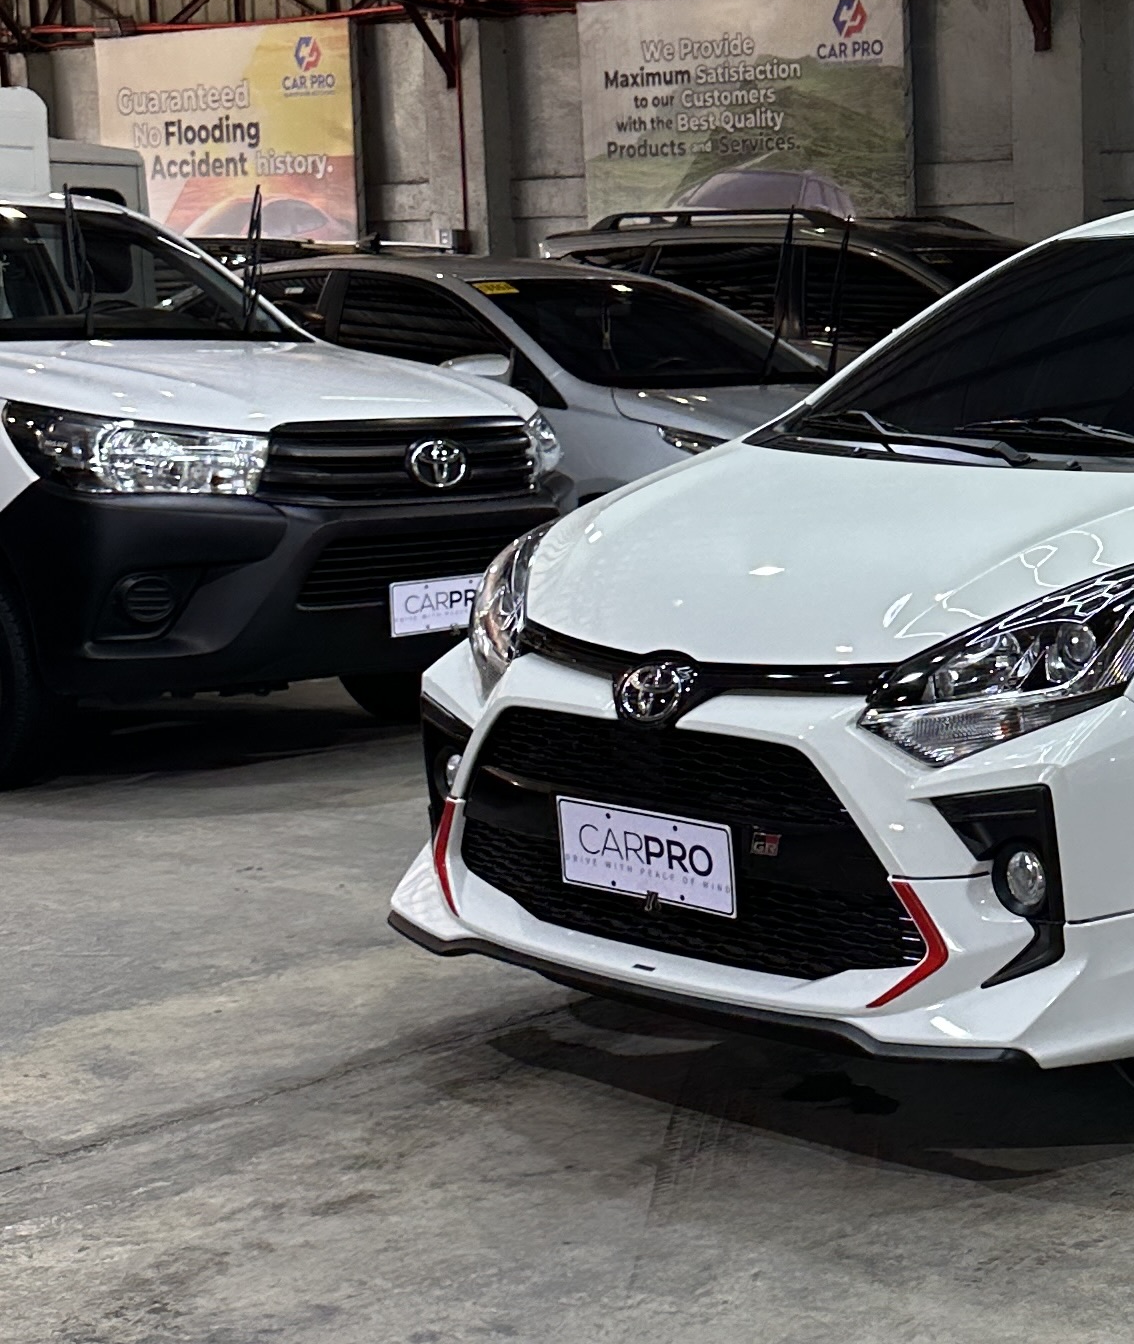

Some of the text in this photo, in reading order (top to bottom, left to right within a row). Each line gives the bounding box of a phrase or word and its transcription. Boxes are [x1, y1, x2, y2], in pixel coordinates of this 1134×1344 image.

[641, 32, 755, 63] We Provide
[817, 39, 884, 59] CAR PRO
[281, 73, 336, 91] CAR PRO
[604, 58, 801, 89] Maximum Satisfaction
[116, 79, 251, 116] Guaranteed
[633, 86, 777, 109] to our Customers
[133, 115, 261, 148] No Flooding
[616, 106, 785, 134] with the Best Quality
[607, 132, 801, 159] Products and Services.
[151, 149, 334, 181] Accident history.
[404, 589, 477, 614] CARPR
[579, 824, 713, 877] CARPRO
